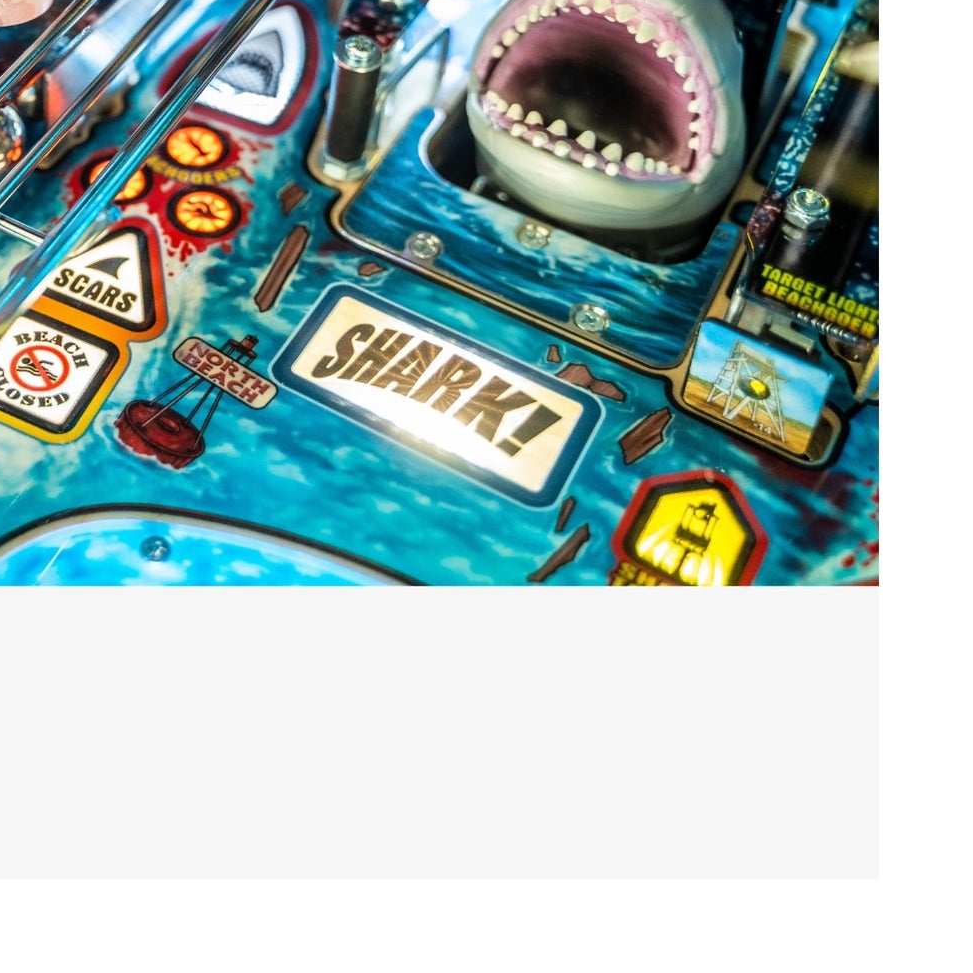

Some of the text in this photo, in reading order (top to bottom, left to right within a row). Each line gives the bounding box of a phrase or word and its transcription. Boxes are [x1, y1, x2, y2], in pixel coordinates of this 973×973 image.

[53, 268, 138, 313] SCARS
[761, 263, 879, 325] TARGET LIGHT
[762, 279, 877, 339] BEACHGOER
[13, 330, 89, 369] BEACH
[189, 340, 271, 395] NORTH
[181, 352, 259, 404] BEACH
[311, 323, 563, 459] SHARK!
